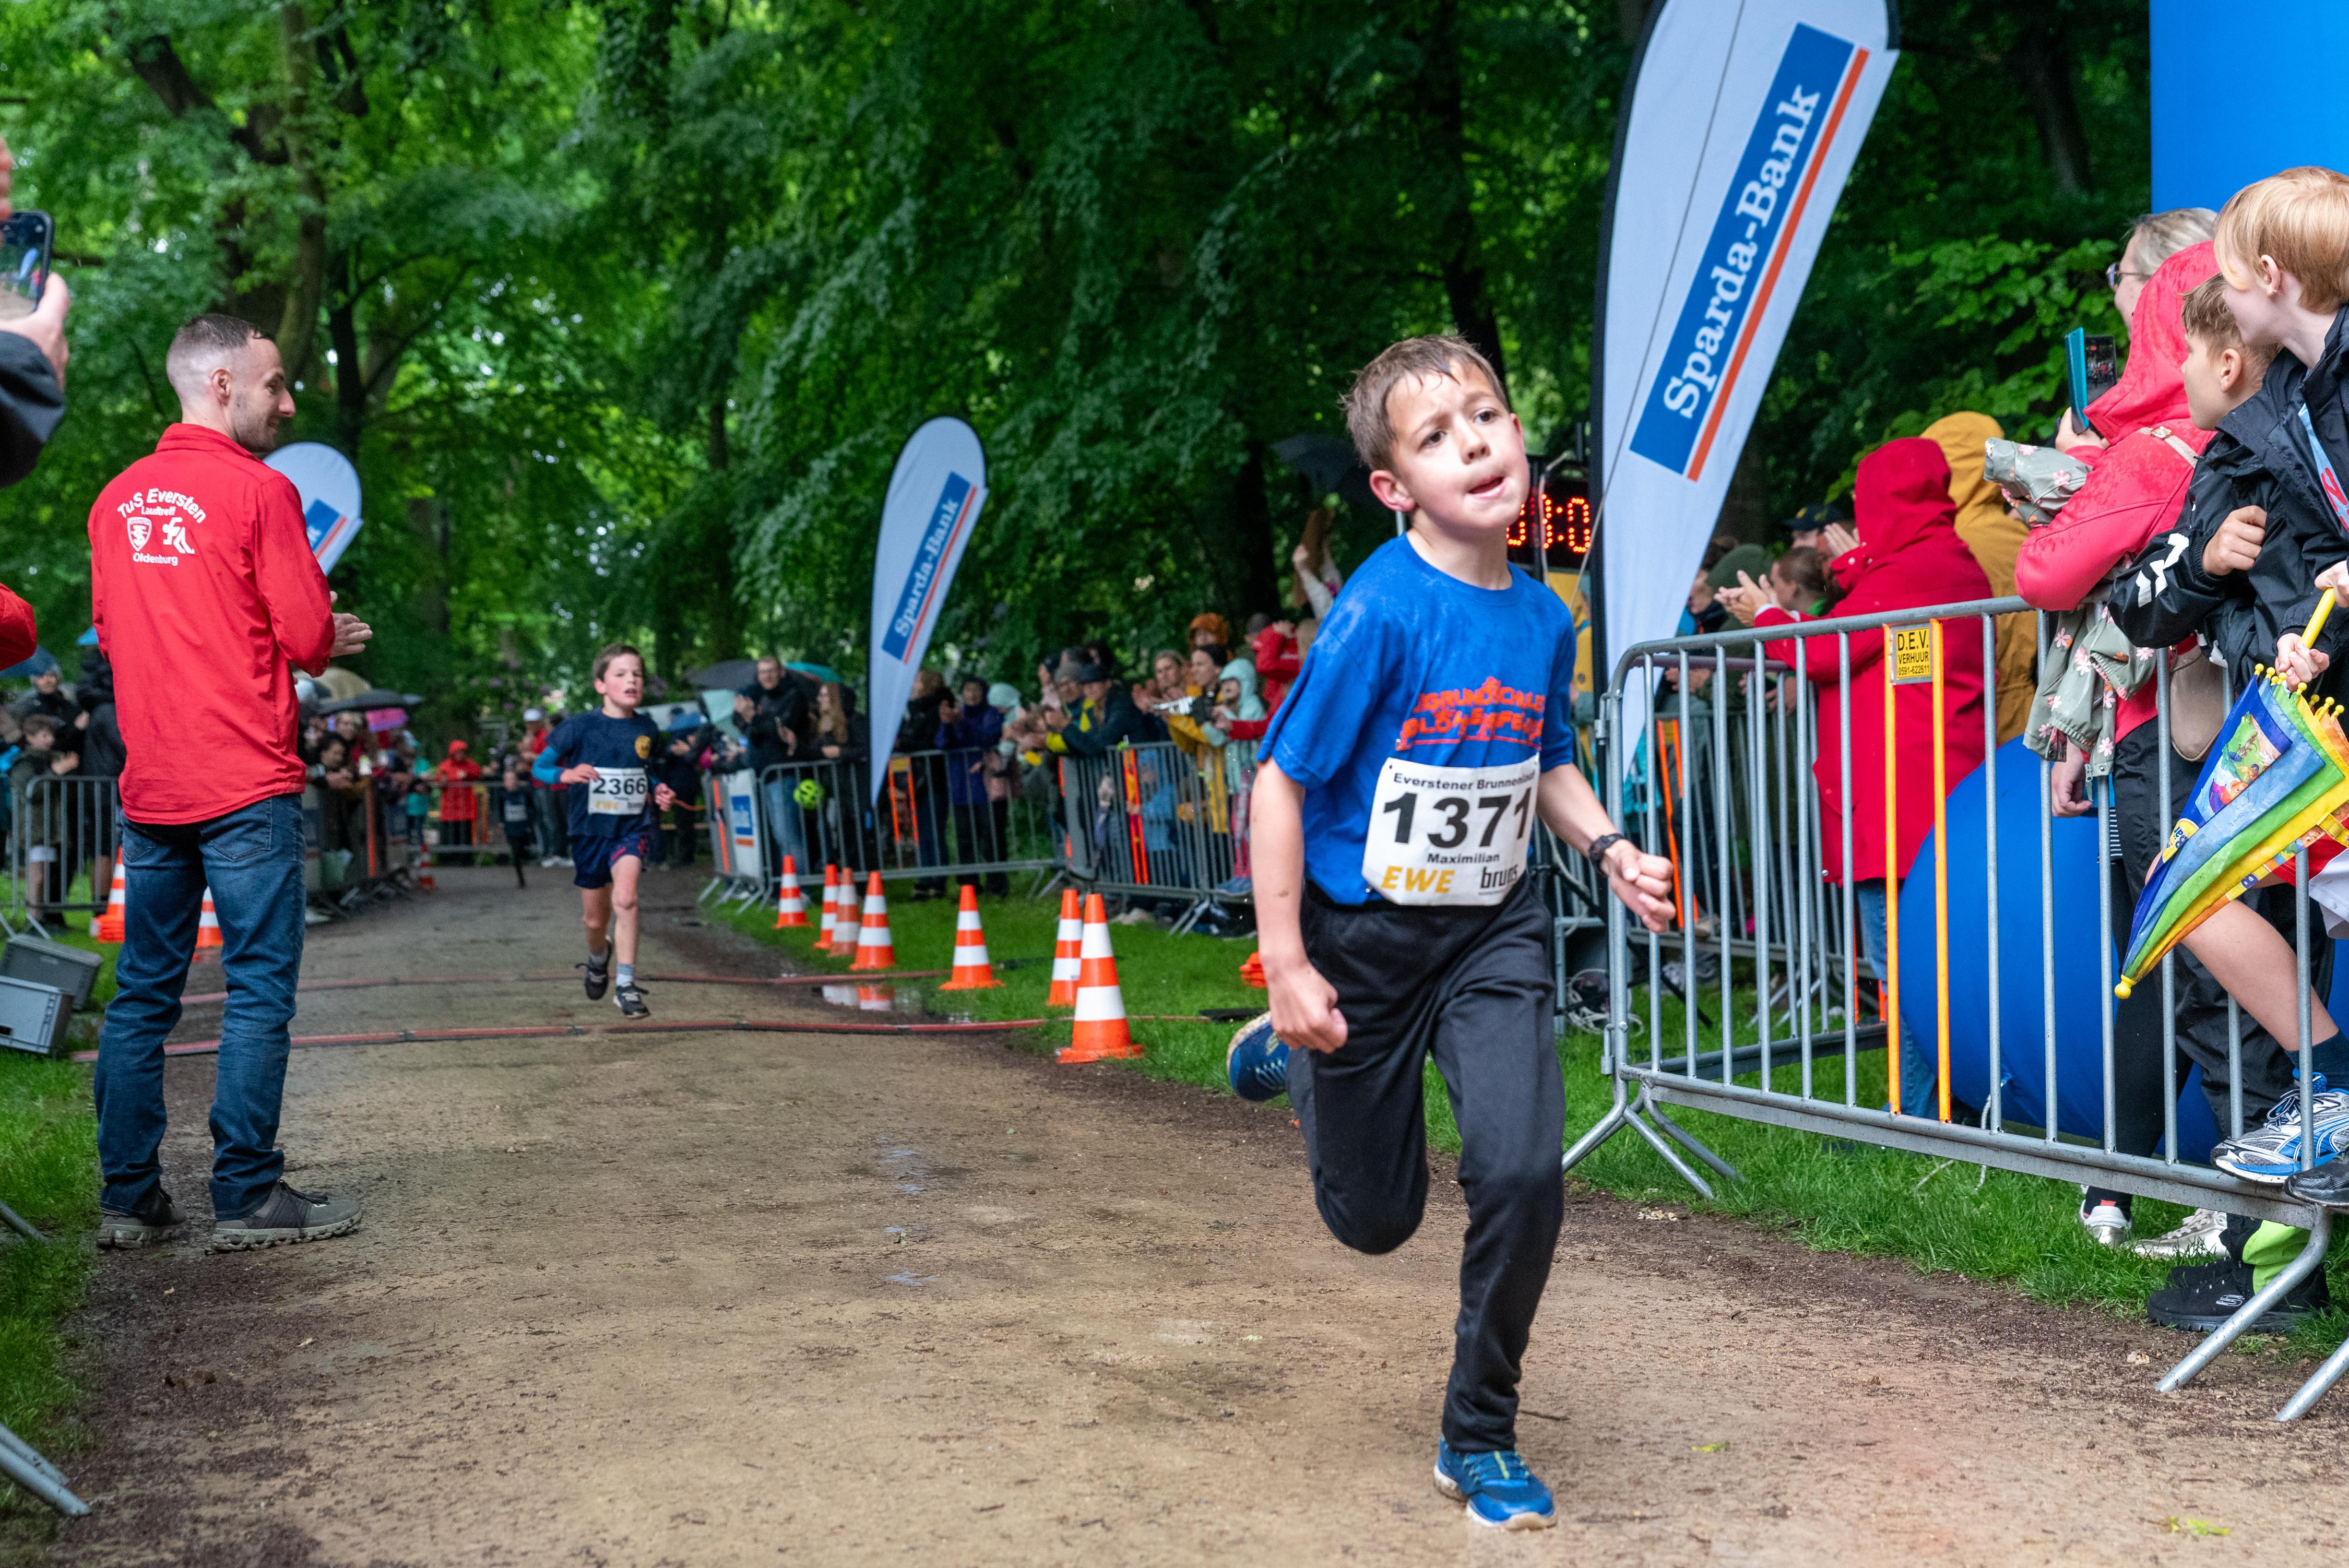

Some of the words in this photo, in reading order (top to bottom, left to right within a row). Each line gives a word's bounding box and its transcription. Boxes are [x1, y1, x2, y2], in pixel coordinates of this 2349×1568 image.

[1663, 84, 1821, 419] Sparda-Bank
[117, 492, 144, 518] TuS
[146, 488, 206, 524] Eversten
[140, 505, 176, 516] Lauftreff
[132, 552, 179, 566] Oldenburg
[894, 498, 959, 638] Sparda-Bank
[1897, 630, 1929, 651] D.E.V.
[1898, 651, 1929, 664] VERHUUR
[1899, 664, 1930, 676] 0591-622611
[592, 777, 646, 795] 2366
[1394, 772, 1474, 790] Everstener
[1383, 787, 1533, 849] 1371
[1427, 852, 1500, 864] Maximilian
[1381, 865, 1456, 894] EWE
